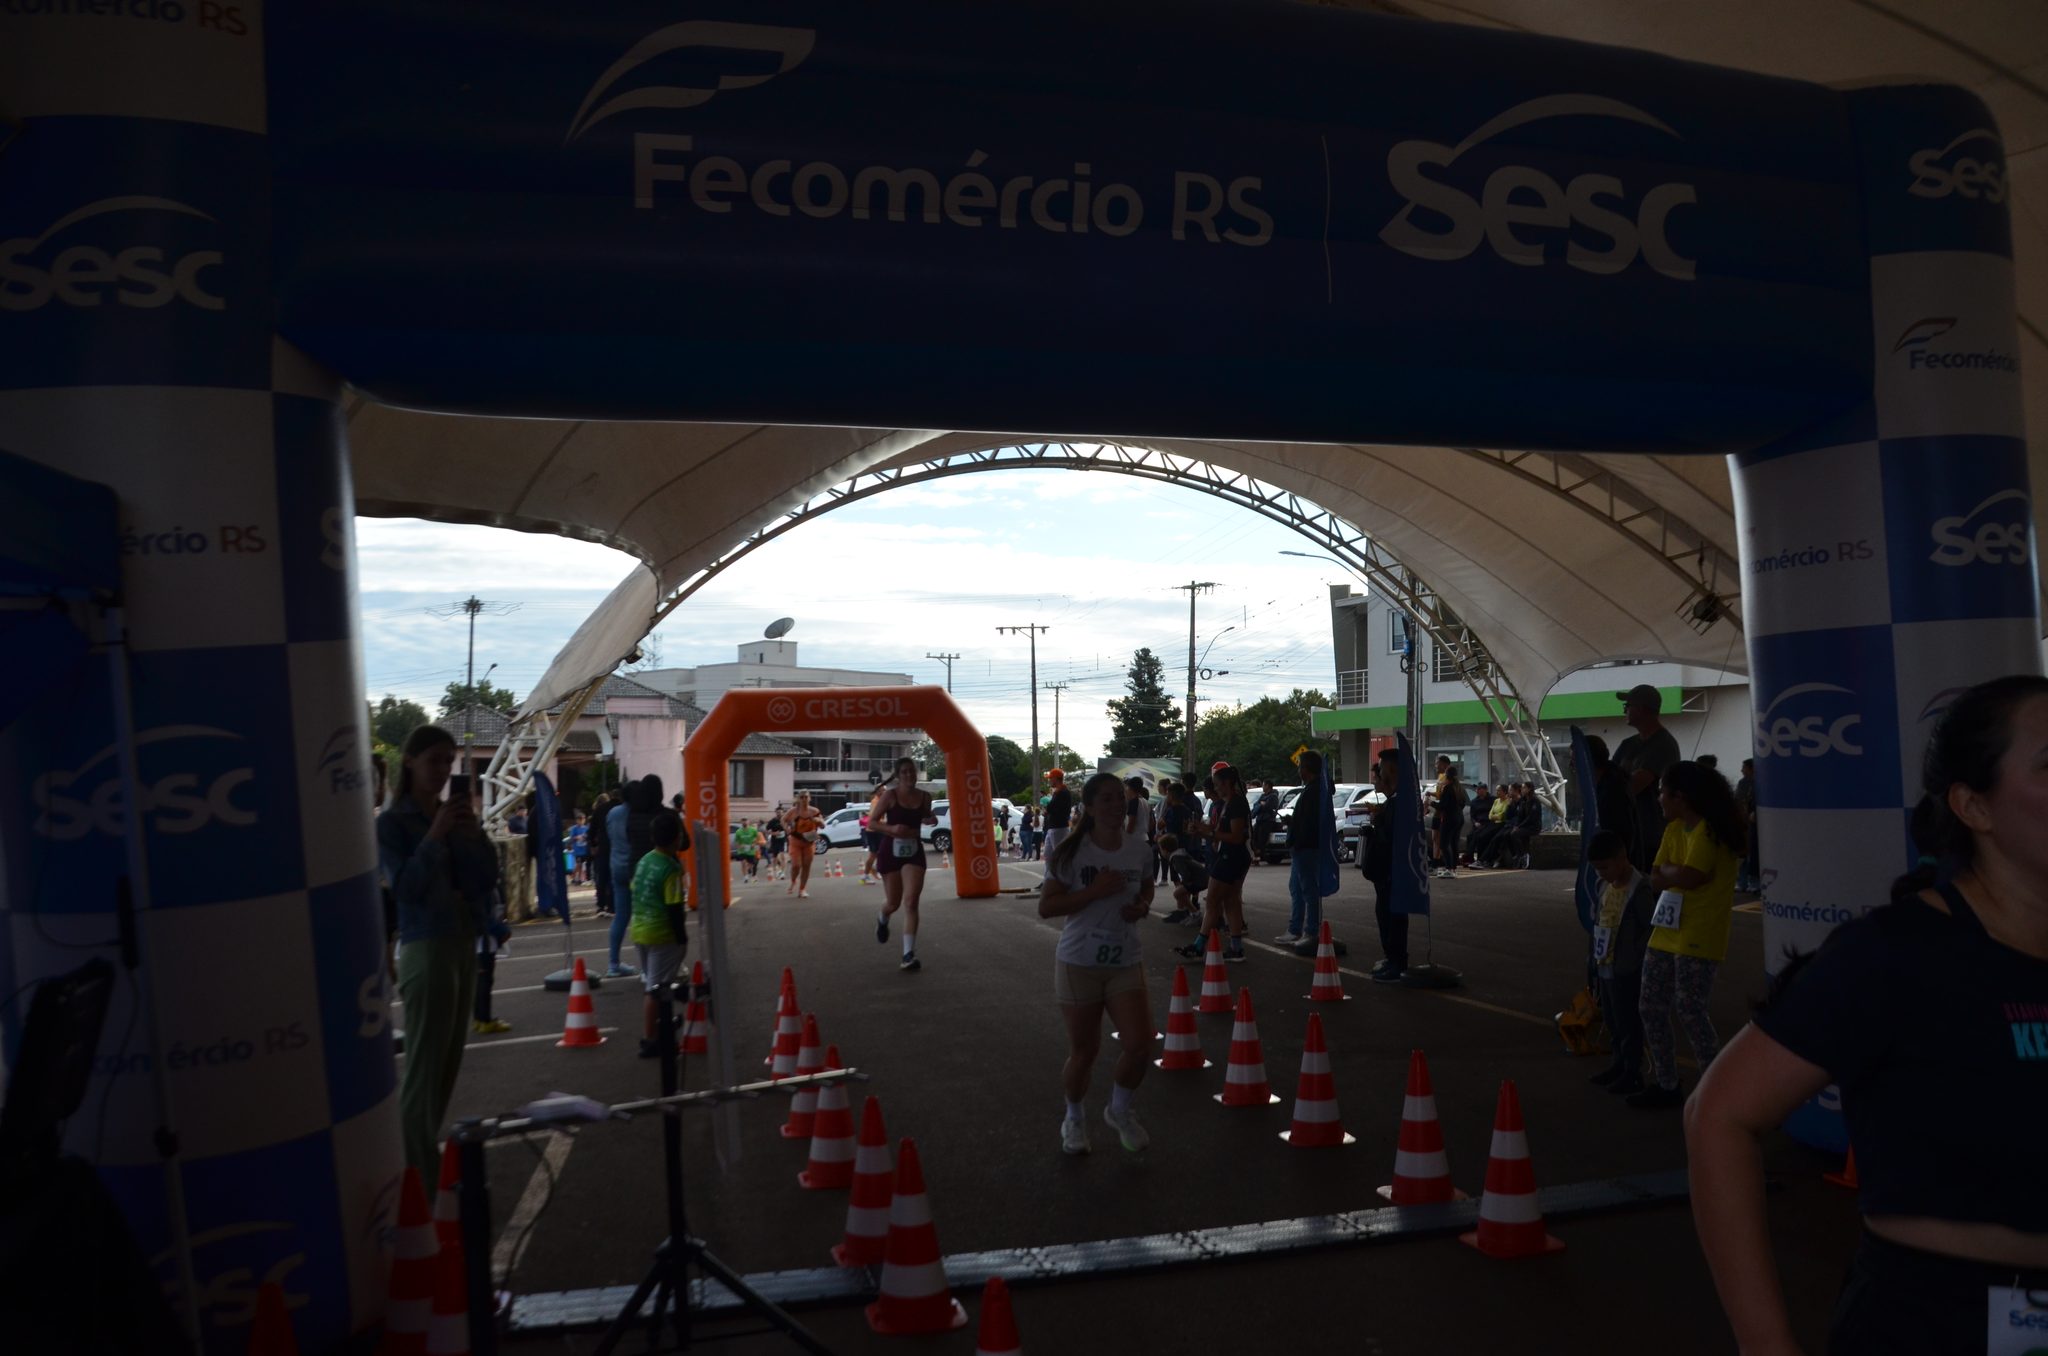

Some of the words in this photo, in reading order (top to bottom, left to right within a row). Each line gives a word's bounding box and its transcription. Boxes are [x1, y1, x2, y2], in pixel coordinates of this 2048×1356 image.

[199, 1, 248, 36] RS
[633, 132, 1143, 237] Fecomércio
[1172, 172, 1275, 247] RS
[1907, 148, 2006, 204] Ses
[1378, 139, 1698, 281] Sesc
[0, 237, 226, 312] Sesc
[121, 526, 208, 556] ércio
[220, 526, 266, 553] RS
[1837, 540, 1874, 562] RS
[1928, 516, 2028, 566] Ses
[804, 697, 909, 719] CRESOL
[701, 773, 718, 832] ESOL
[965, 763, 989, 848] CRESOL
[1657, 902, 1675, 926] 93
[1096, 944, 1123, 965] 82
[265, 1021, 309, 1053] RS
